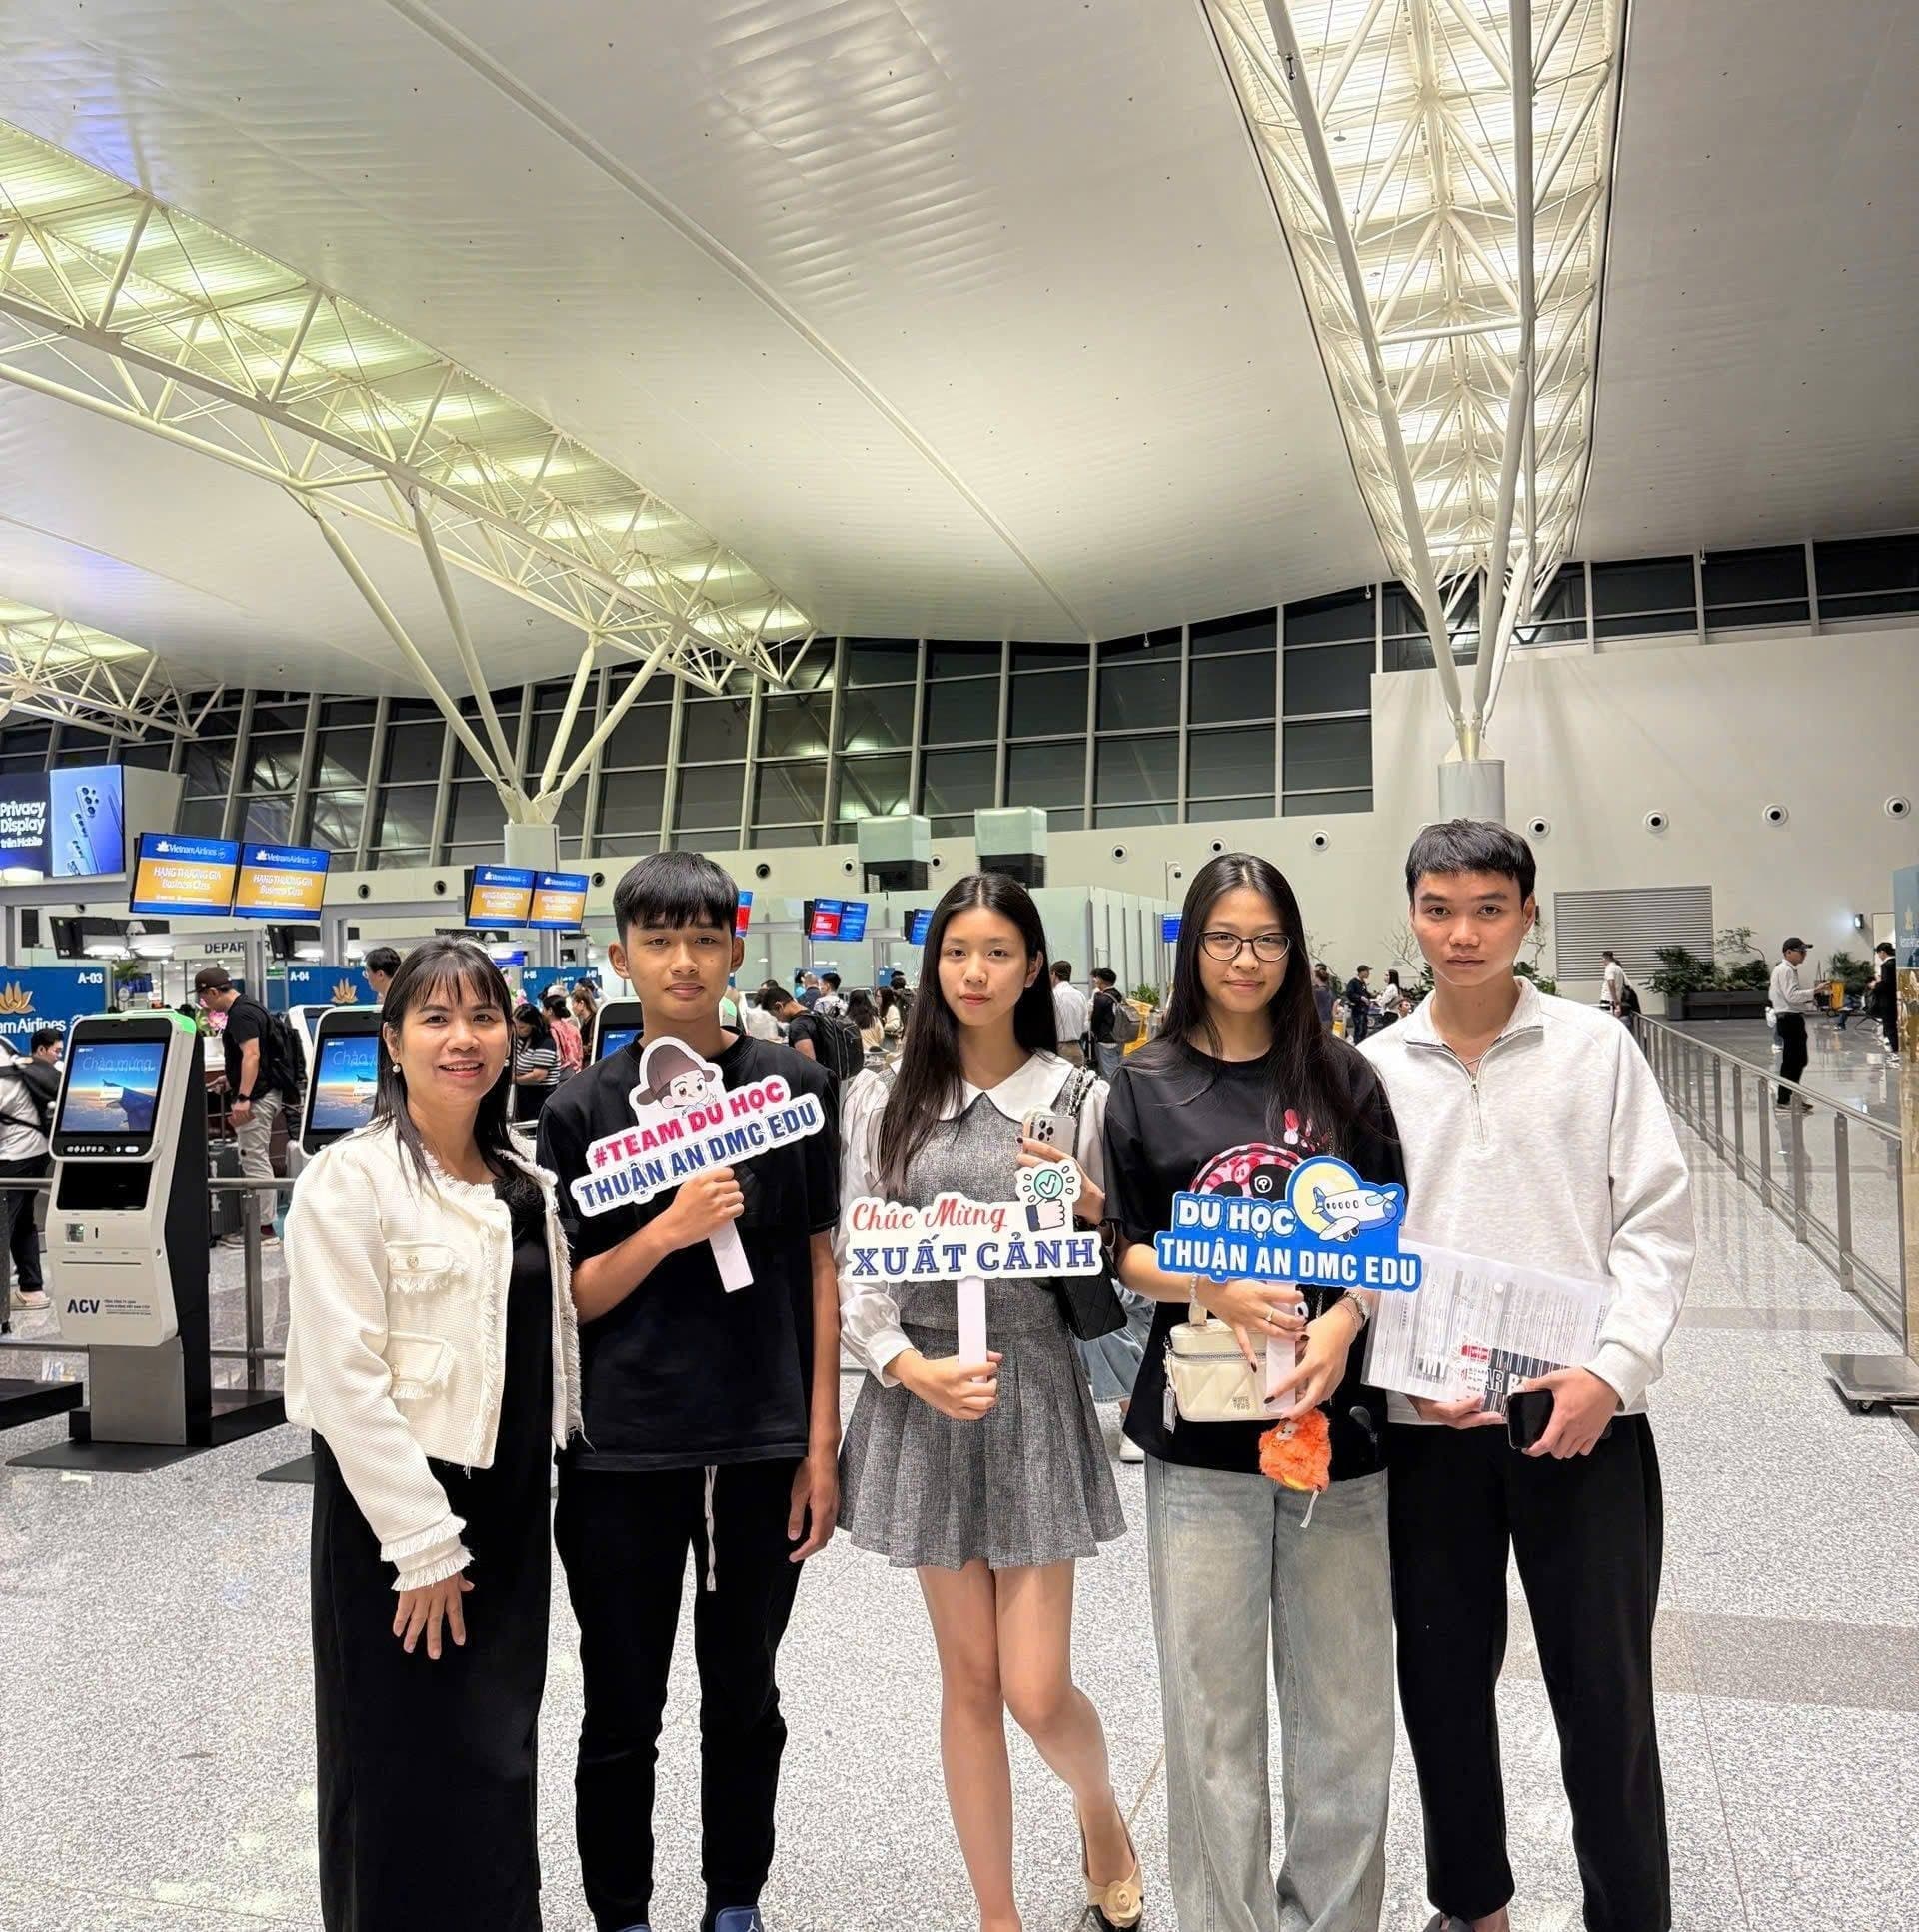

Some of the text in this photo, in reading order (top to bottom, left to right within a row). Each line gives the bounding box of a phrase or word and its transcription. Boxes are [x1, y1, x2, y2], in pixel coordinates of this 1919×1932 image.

[0, 801, 46, 818] Privacy
[1, 817, 46, 836] Display
[78, 972, 103, 984] A-03
[290, 971, 310, 981] A-04
[17, 1017, 67, 1033] Airlines
[593, 1081, 785, 1167] #TEAM DU HỌC
[580, 1102, 818, 1208] THUẬN AN DMC EDU
[852, 1198, 1008, 1233] Chúc Mừng
[1178, 1200, 1296, 1240] DU HỌC
[852, 1231, 1096, 1276] XUẤT CẢNH
[1161, 1237, 1417, 1287] THUẬN AN DMC EDU
[67, 1298, 100, 1314] ACV
